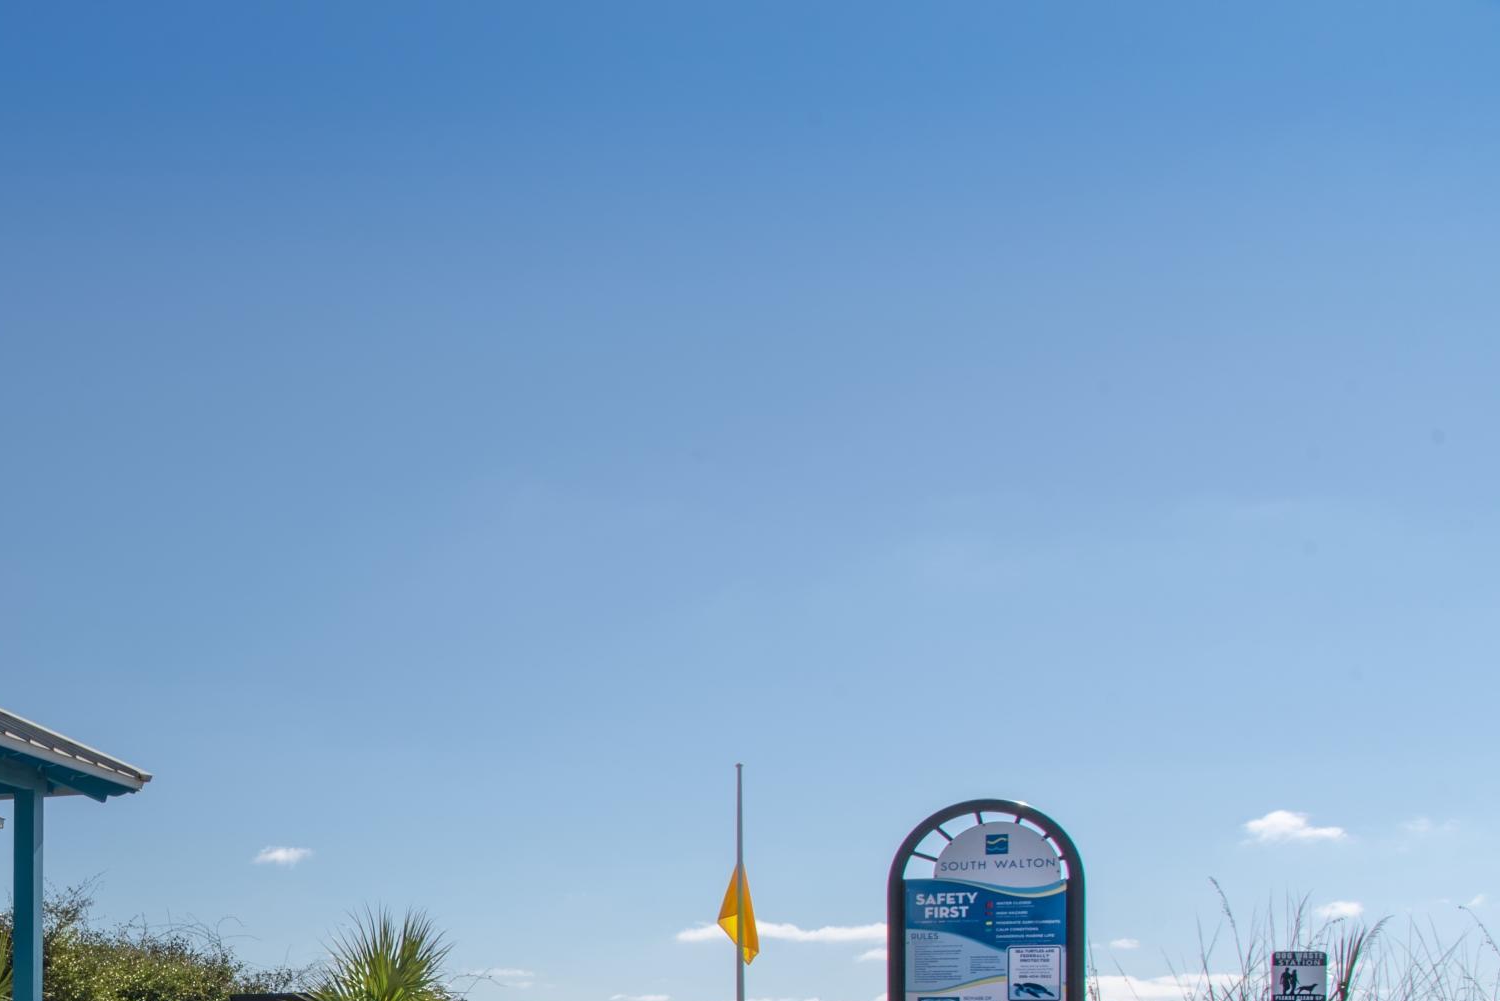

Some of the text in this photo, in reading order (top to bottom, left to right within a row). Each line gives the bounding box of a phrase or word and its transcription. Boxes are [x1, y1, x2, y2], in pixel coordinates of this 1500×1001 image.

[940, 858, 1056, 871] SOUTH WALTON
[915, 892, 978, 906] SAFETY
[924, 906, 969, 919] FIRST
[910, 932, 939, 940] RULES
